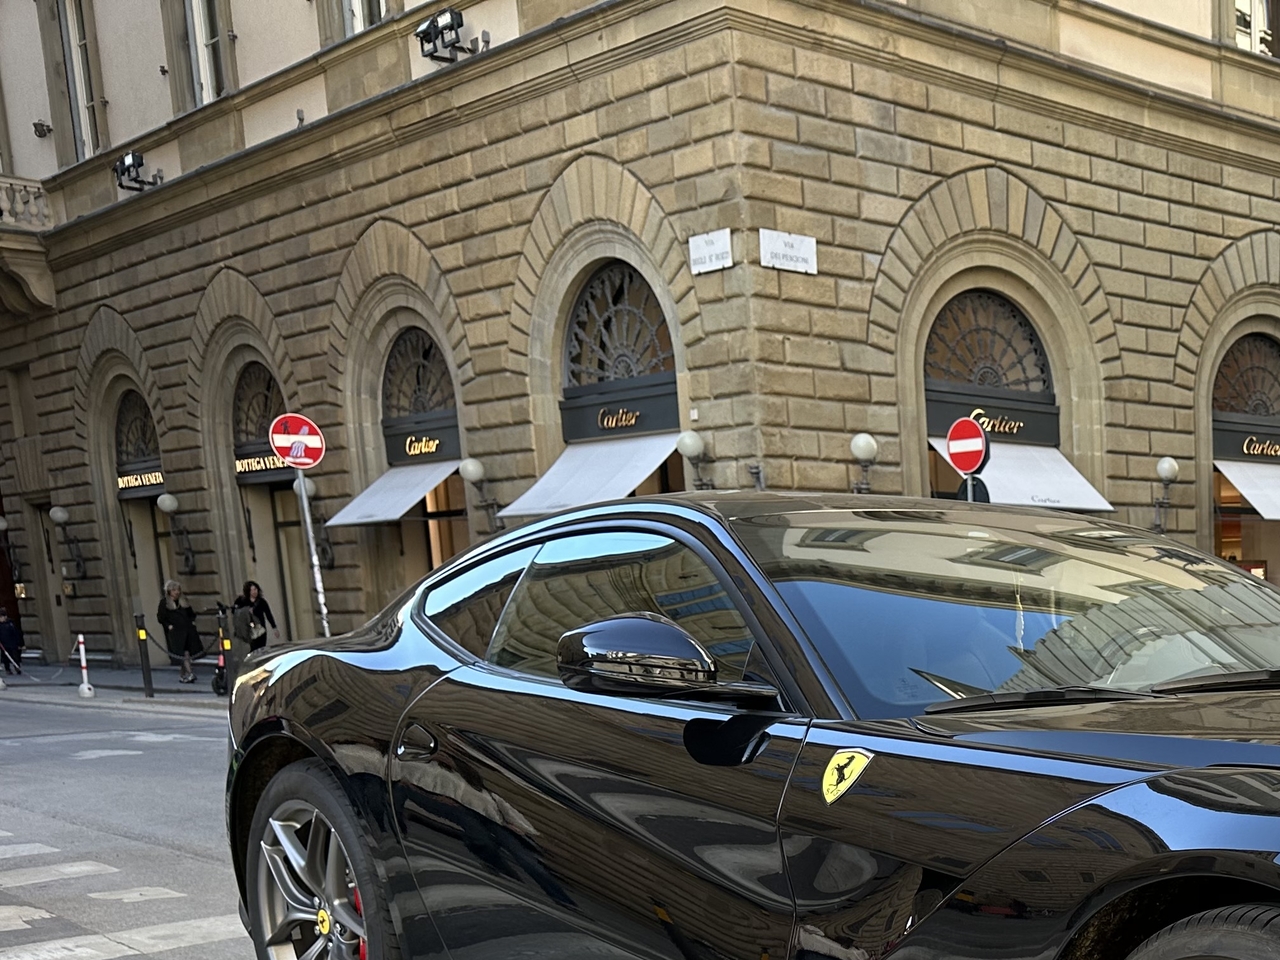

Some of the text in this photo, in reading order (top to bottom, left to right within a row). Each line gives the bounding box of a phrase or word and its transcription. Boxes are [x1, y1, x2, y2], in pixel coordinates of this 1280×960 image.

[598, 407, 640, 429] Cartier
[405, 435, 440, 456] Cartier
[236, 458, 265, 473] BOTTEGA
[118, 472, 163, 489] BOTTEGA VENETA
